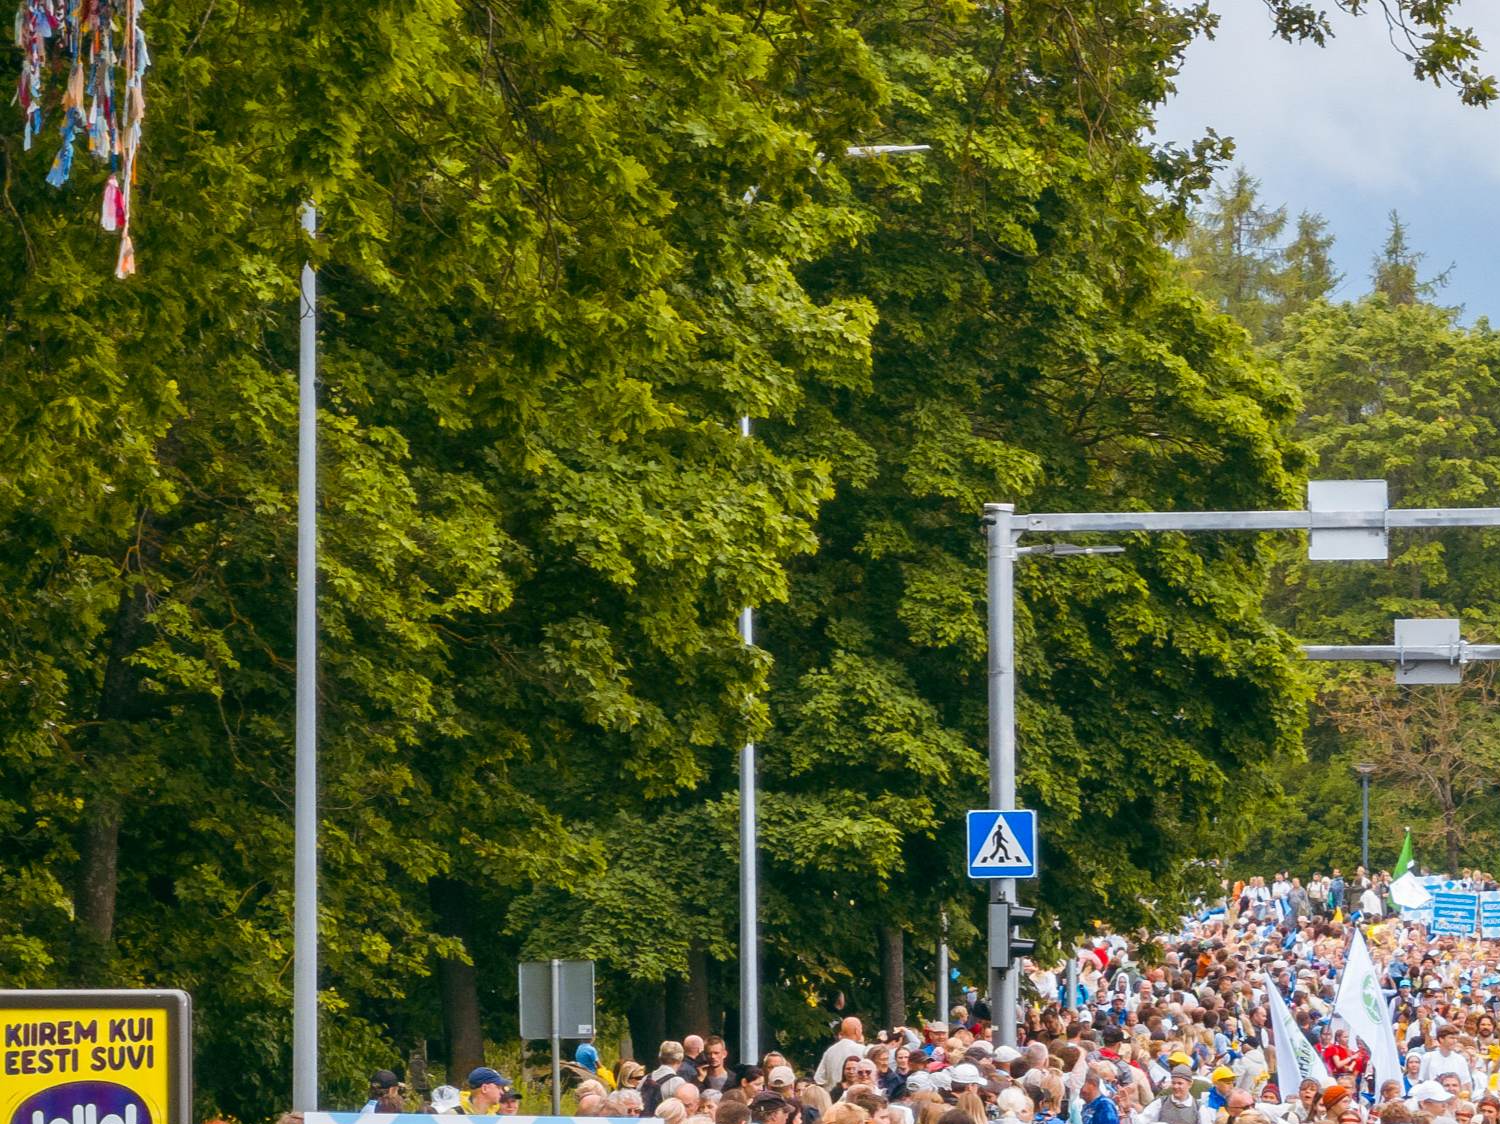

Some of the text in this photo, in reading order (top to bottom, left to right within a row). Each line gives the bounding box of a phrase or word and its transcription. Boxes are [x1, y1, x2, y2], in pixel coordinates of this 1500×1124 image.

[5, 1017, 153, 1047] KIIREM KUI
[5, 1044, 154, 1075] EESTI SUVI
